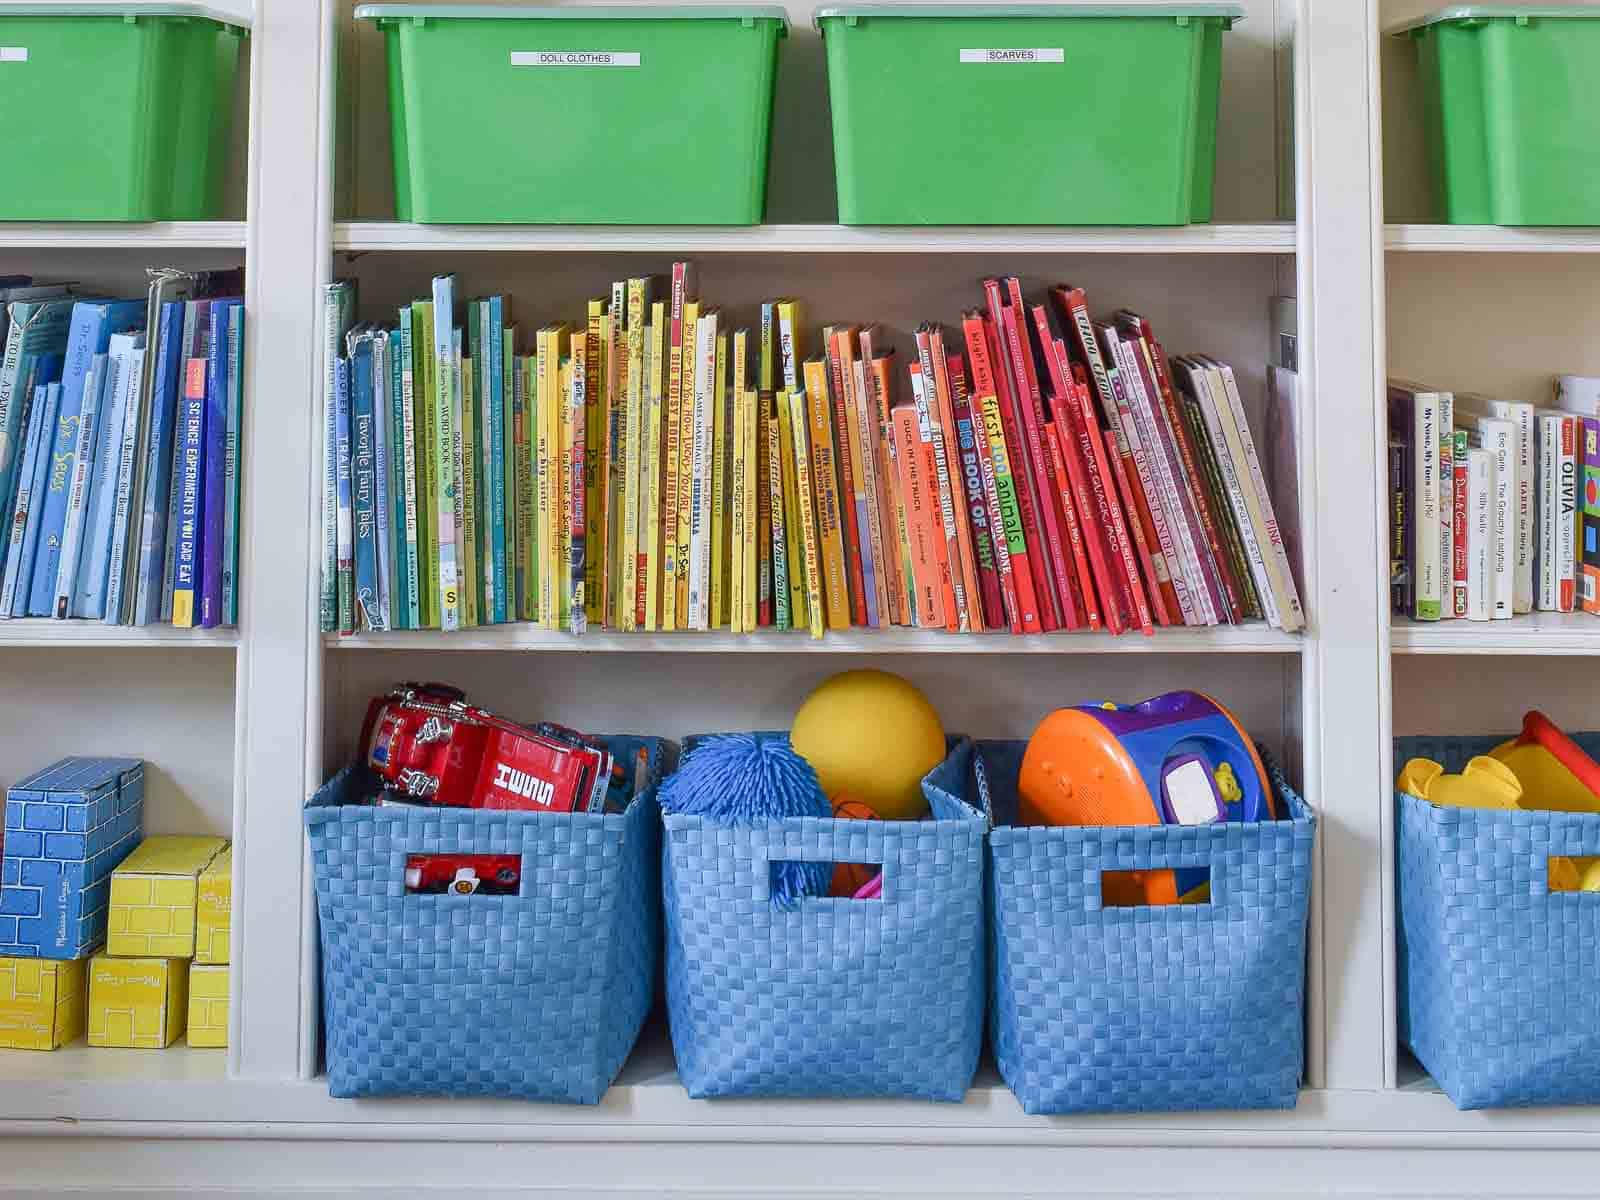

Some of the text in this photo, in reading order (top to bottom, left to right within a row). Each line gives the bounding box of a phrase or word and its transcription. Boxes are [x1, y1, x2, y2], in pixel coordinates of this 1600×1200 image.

[539, 54, 611, 63] DOLL CLOTHES
[989, 51, 1034, 60] SCARVES
[587, 315, 599, 323] IF
[586, 354, 599, 372] THE
[669, 353, 680, 370] BIG
[970, 331, 986, 363] bright
[1077, 314, 1112, 401] CHOO CHOO
[338, 364, 347, 414] COOPER
[574, 381, 583, 398] Kirk
[668, 379, 679, 415] NOISY
[954, 373, 968, 407] TIME
[1422, 407, 1432, 419] My
[538, 438, 545, 454] my
[617, 389, 626, 493] WEMBERLY WORRIED
[667, 420, 678, 452] BOOK
[974, 413, 986, 448] HORAN
[1422, 422, 1432, 449] Nose,
[49, 414, 80, 494] Six Seuss
[338, 436, 349, 480] TRAIN
[538, 458, 546, 475] big
[691, 392, 703, 535] JAMES MARSHALL'S CINDERELLA
[902, 419, 921, 511] DUCK IN THE TRUCK
[930, 422, 949, 488] TROMBONE
[1422, 450, 1432, 462] My
[355, 413, 374, 537] Favorite Fairy Tales
[561, 479, 570, 494] not
[798, 466, 807, 482] The
[981, 398, 1023, 544] first 100 animals
[1422, 464, 1432, 486] Toes
[178, 401, 200, 583] SCIENCE EXPERIMENTS YOU CAN EAT
[561, 499, 570, 511] So
[666, 471, 677, 540] DINOSAURS
[801, 500, 810, 508] at
[956, 417, 993, 572] BIG BOOK OF WHY
[1132, 446, 1174, 560] PRINCESS BABY
[1495, 431, 1506, 572] Eric Carle The Grouchy Ladybug
[1519, 480, 1527, 515] HARRY
[561, 514, 570, 542] Scary,
[802, 509, 811, 522] the
[981, 456, 1012, 575] CONSTRUCTION ZONE
[803, 525, 813, 540] End
[805, 542, 813, 550] of
[1264, 518, 1281, 546] PINK
[807, 567, 817, 591] Block
[1173, 575, 1192, 614] KATZ
[446, 591, 456, 604] S
[493, 762, 555, 807] HESS
